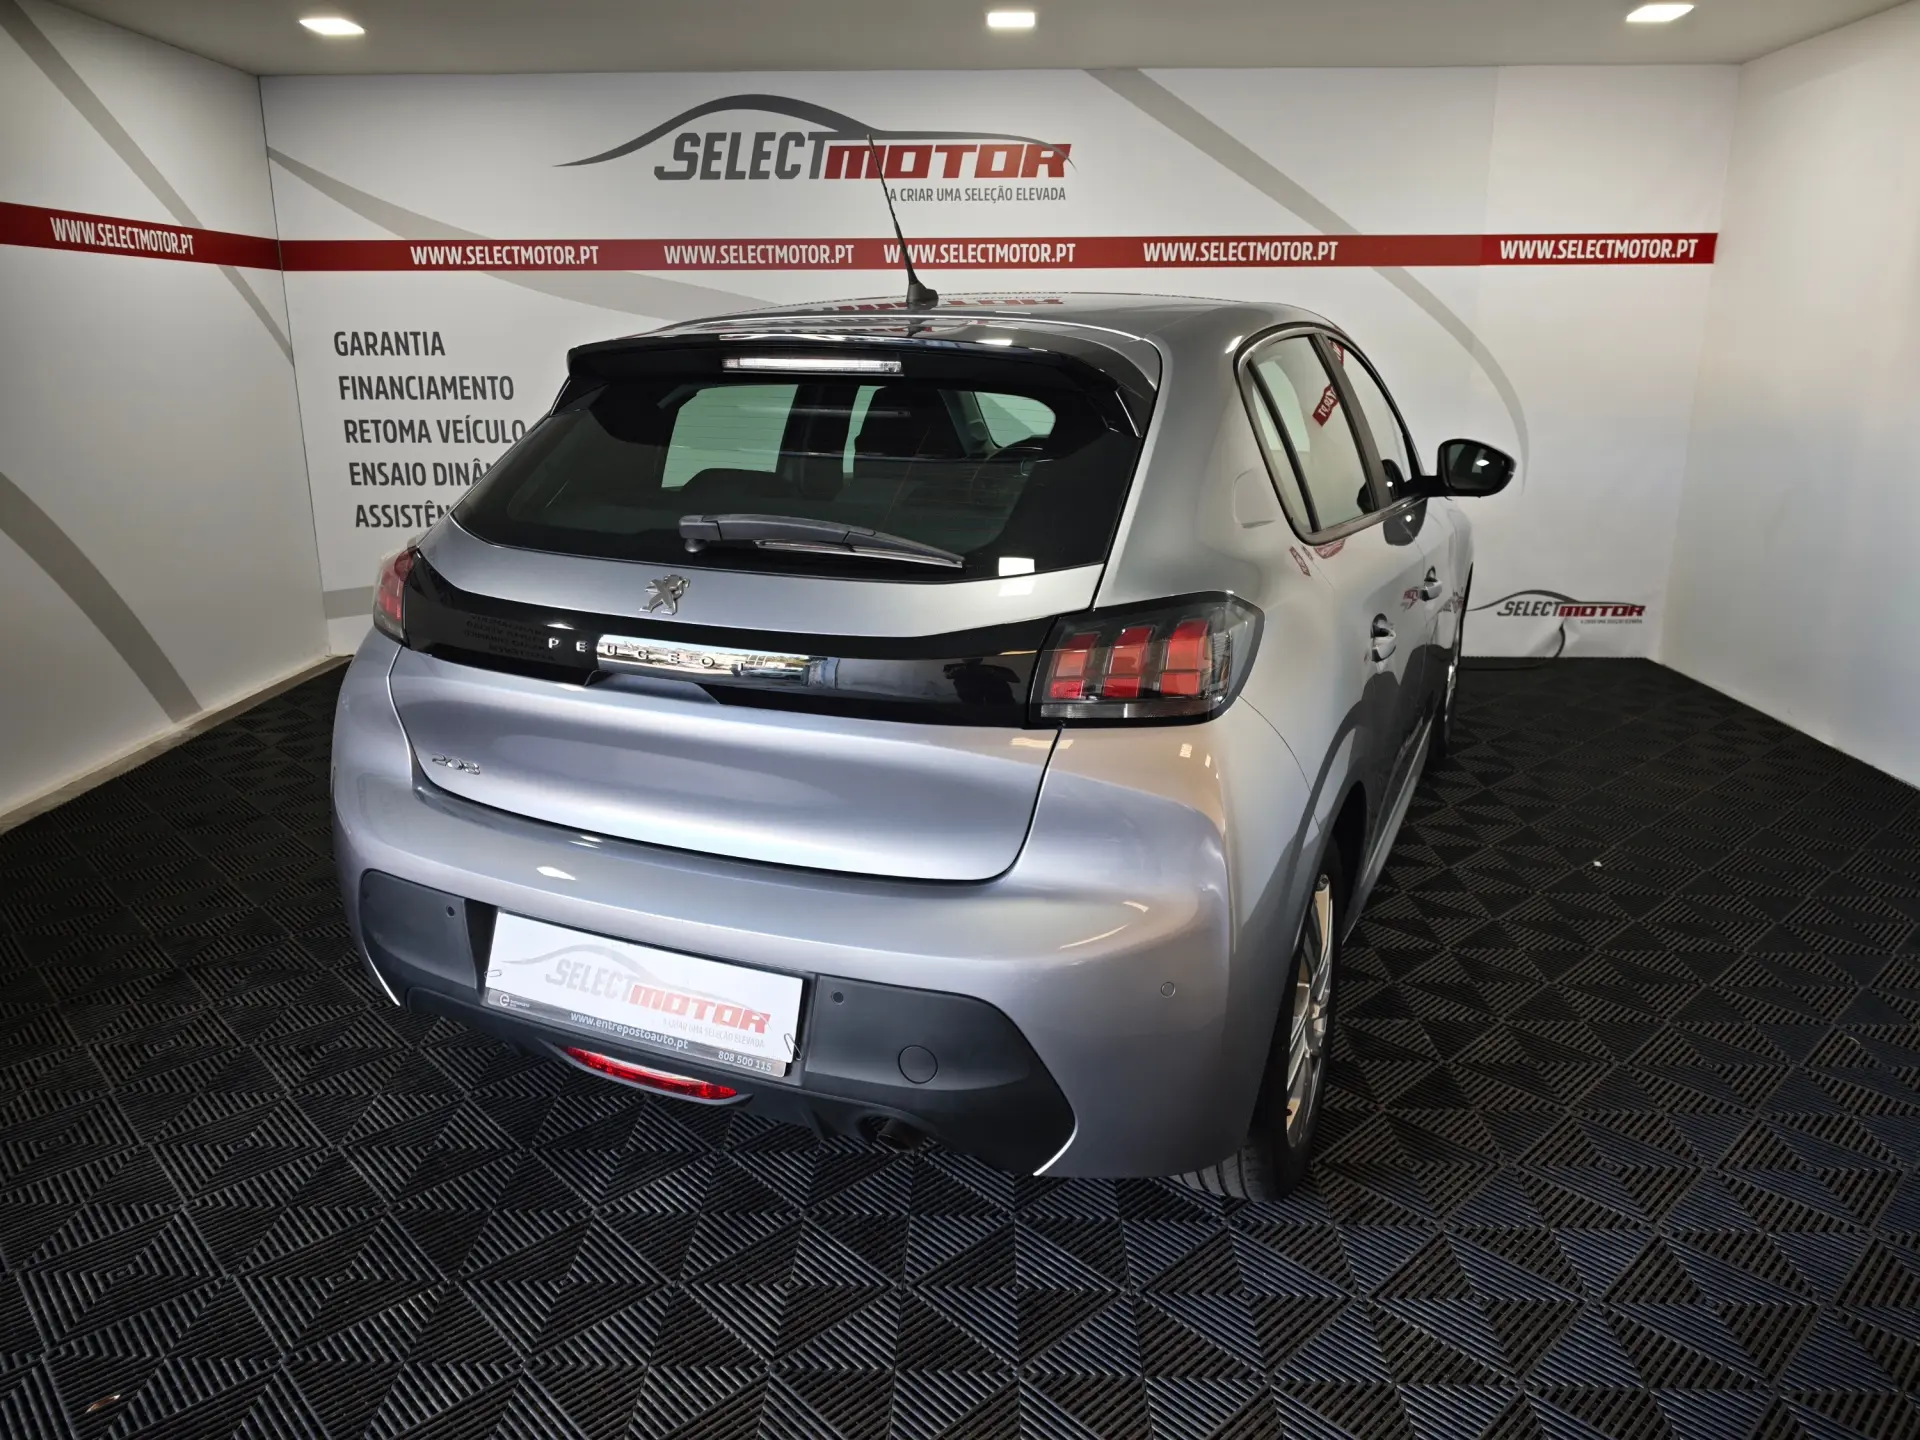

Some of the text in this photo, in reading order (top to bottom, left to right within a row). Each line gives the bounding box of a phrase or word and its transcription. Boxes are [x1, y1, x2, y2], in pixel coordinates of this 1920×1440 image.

[900, 188, 933, 201] CRIAR
[937, 188, 961, 201] UMA
[965, 185, 1012, 203] SELEÇÃO
[1016, 187, 1066, 200] ELEVADA
[50, 217, 194, 255] WWW.SELECTMOTOR.PT
[410, 245, 599, 265] WWW.SELECTMOTOR.PT
[664, 244, 854, 264] WWW.SELECTMOTOR.PT
[1143, 241, 1338, 262] WWW.SELECTMOTOR.PT
[1500, 239, 1698, 259] WWW.SELECTMOTOR.PT
[334, 331, 445, 356] GARANTIA
[338, 376, 514, 400] FINANCIAMENTO
[344, 414, 526, 443] RETOMA VEÍCULO
[349, 458, 491, 486] ENSAIO DINÂ
[548, 637, 744, 675] PEUGEOT
[570, 1012, 689, 1050] www.entrepostoauto.pt
[718, 1051, 772, 1072] 808 500 115
